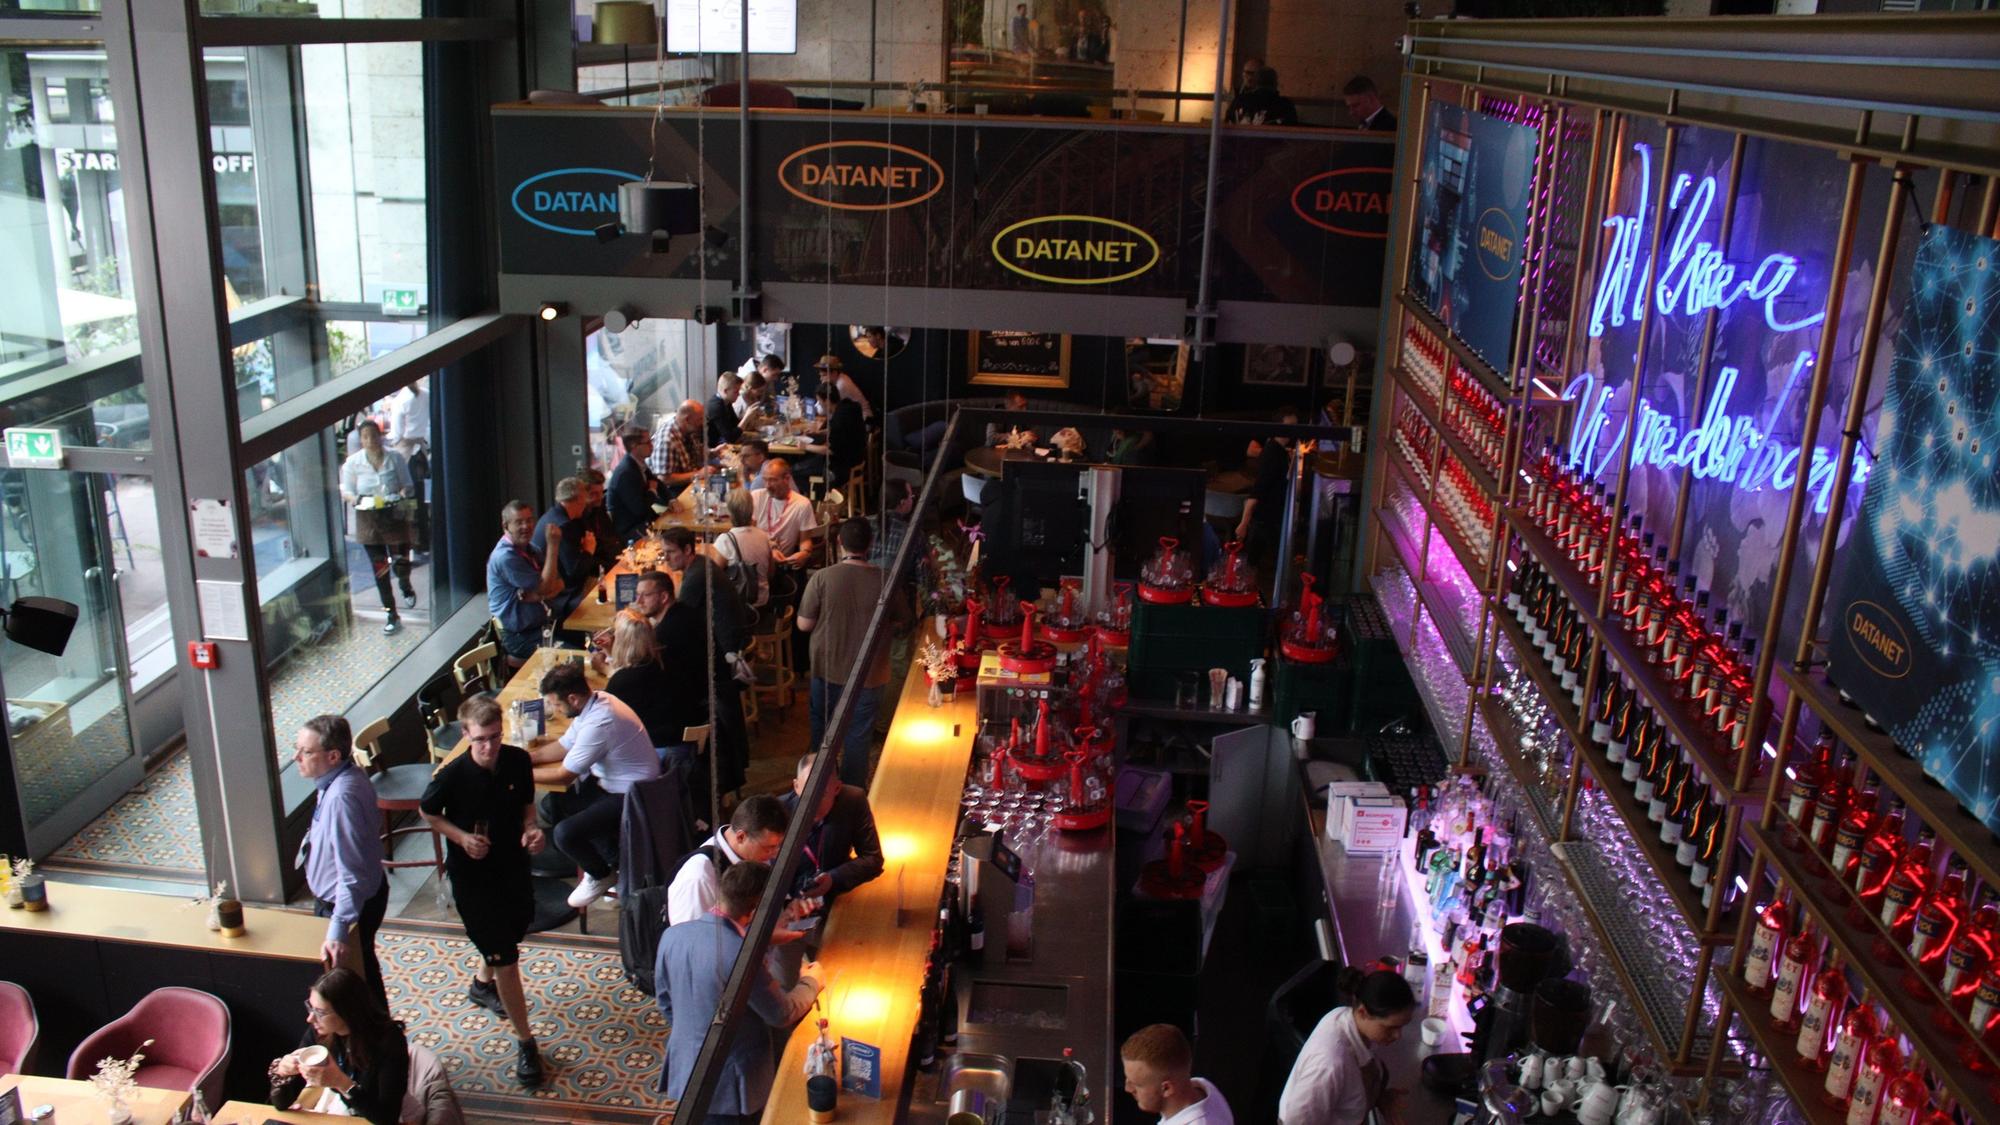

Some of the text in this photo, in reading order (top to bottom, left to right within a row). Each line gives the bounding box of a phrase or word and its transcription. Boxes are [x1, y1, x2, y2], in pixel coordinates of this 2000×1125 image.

[802, 163, 922, 188] DATANET
[534, 190, 620, 213] DATAN
[1016, 237, 1137, 263] DATANET
[1479, 226, 1513, 262] DATANET
[1853, 611, 1905, 665] DATANET
